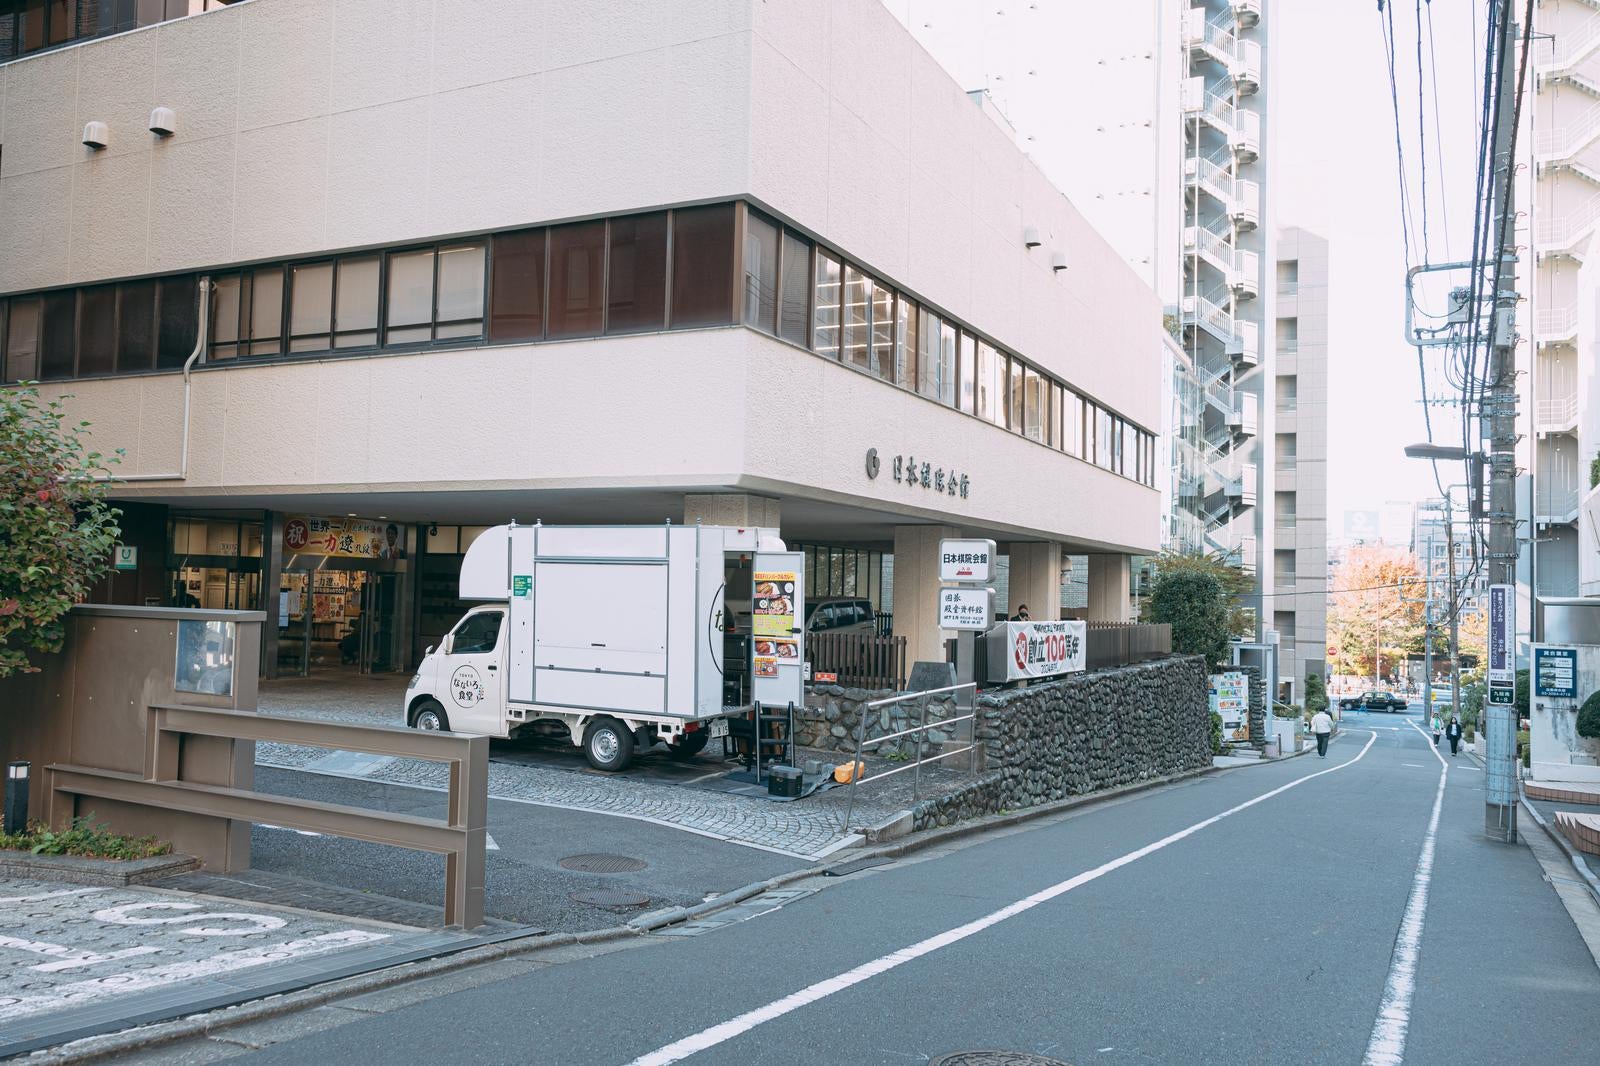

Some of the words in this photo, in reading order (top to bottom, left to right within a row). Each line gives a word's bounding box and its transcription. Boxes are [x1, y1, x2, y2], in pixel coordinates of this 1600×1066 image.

[287, 524, 305, 545] 祝
[943, 553, 987, 564] 日本棋院会館
[453, 678, 479, 690] なないろ
[458, 690, 474, 701] 食堂
